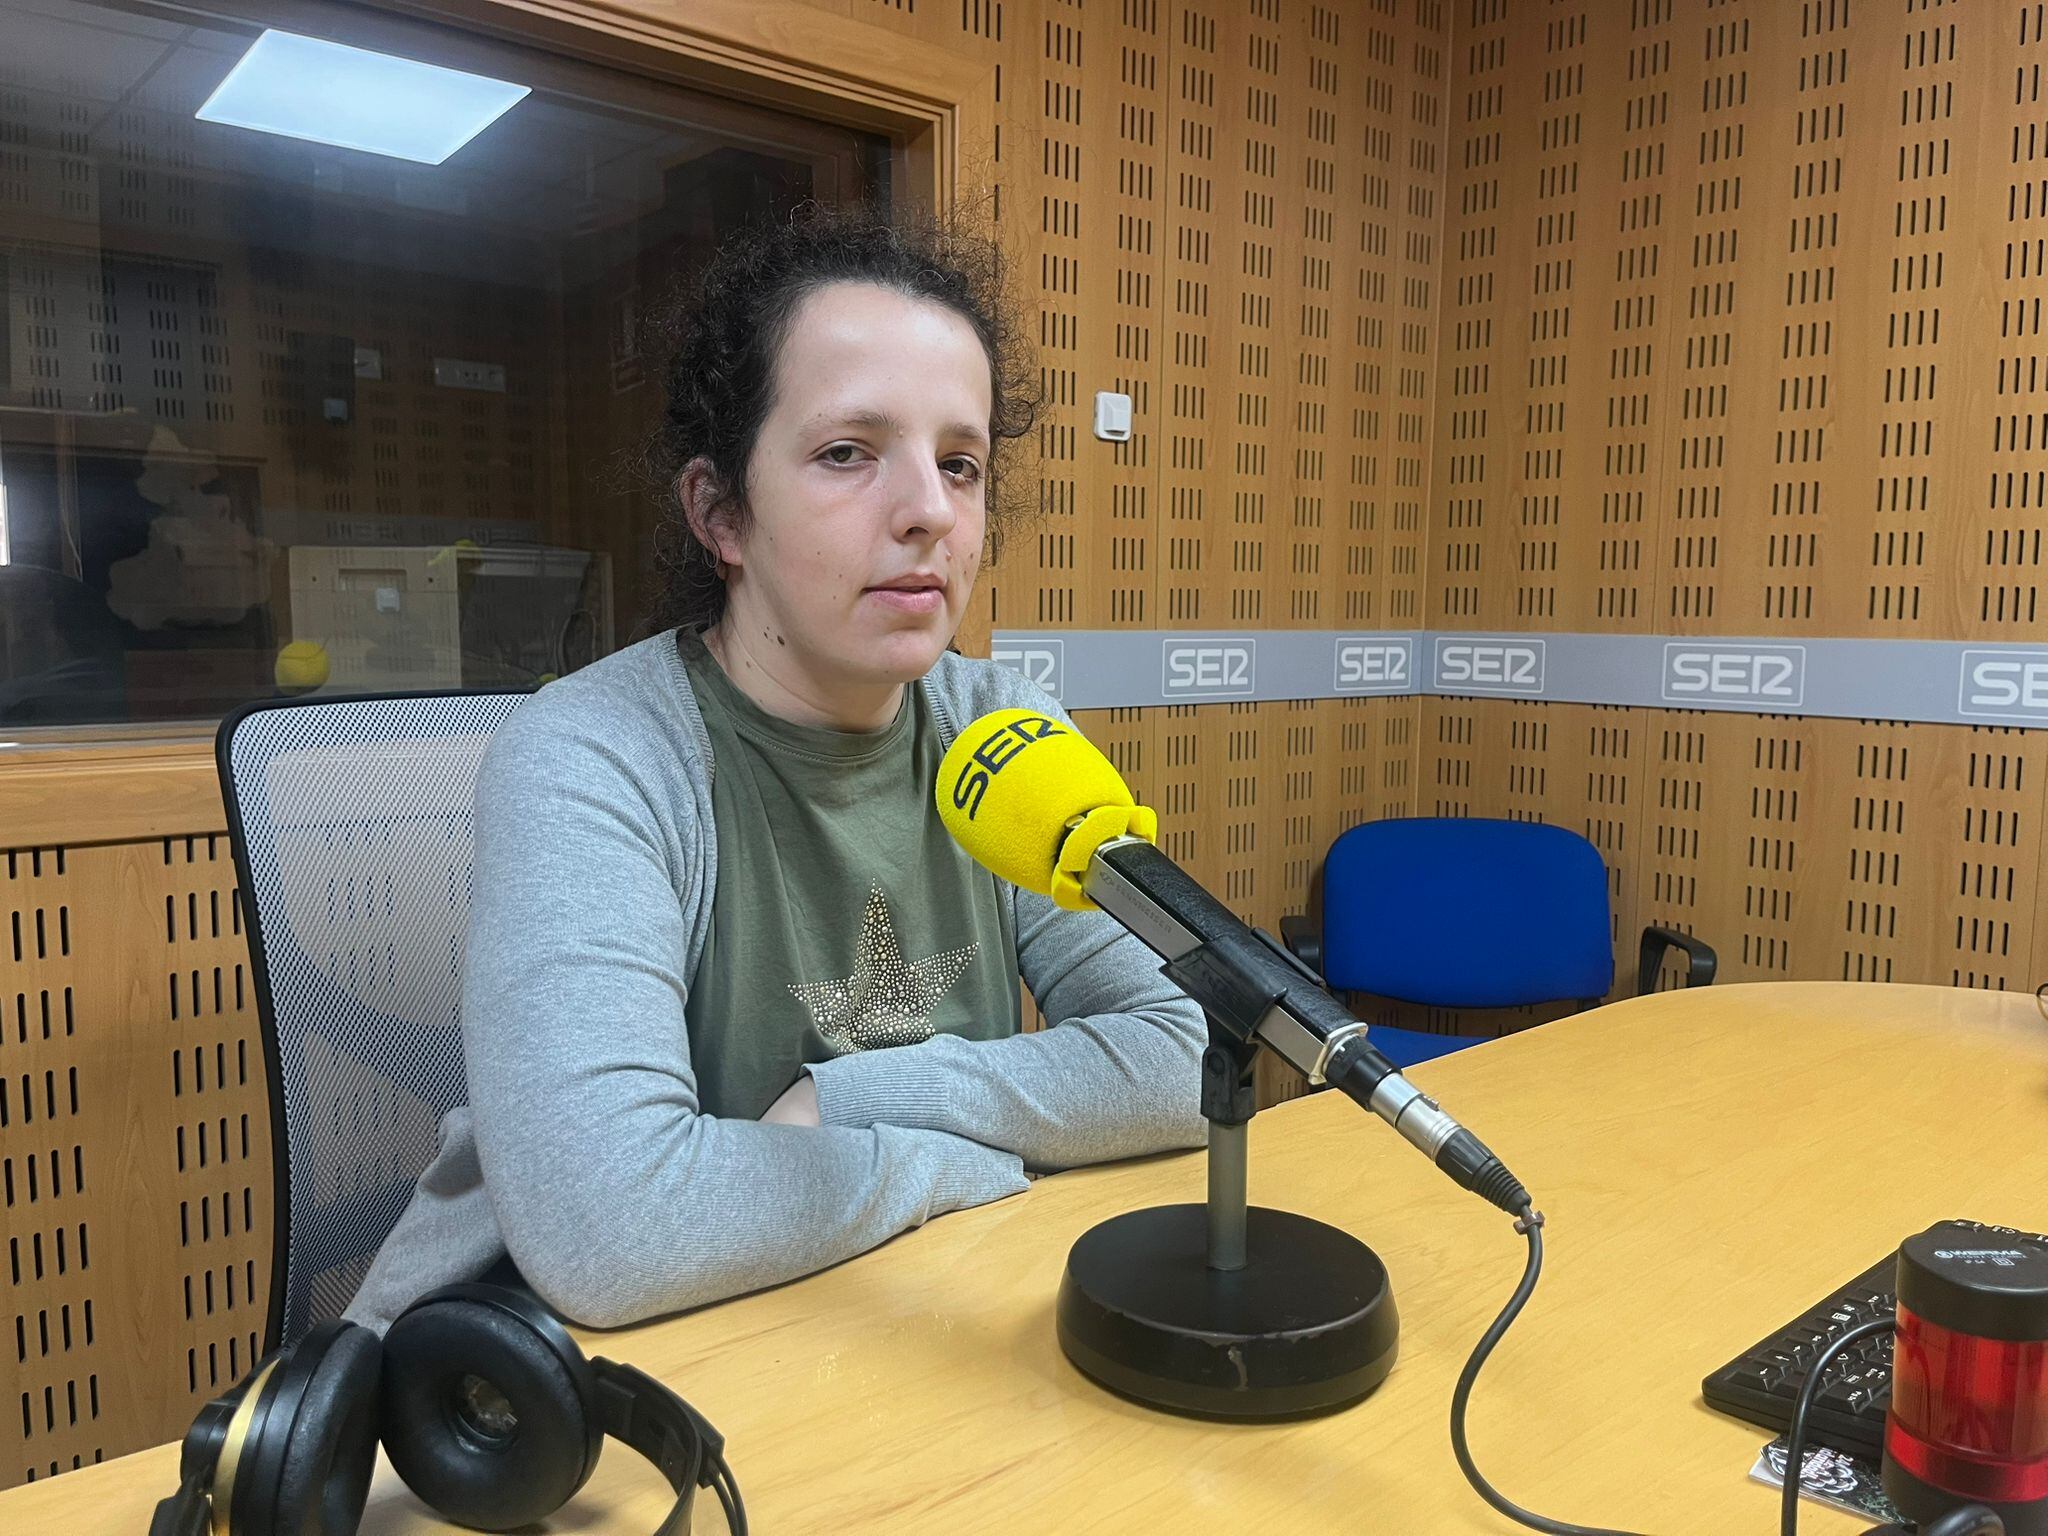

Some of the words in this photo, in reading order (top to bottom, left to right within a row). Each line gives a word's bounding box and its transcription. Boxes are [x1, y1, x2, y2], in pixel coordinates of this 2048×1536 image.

[1169, 648, 1248, 687] SER
[1340, 647, 1406, 681] SER
[1441, 647, 1537, 683] SER
[1671, 653, 1793, 695] SER
[1971, 662, 2048, 707] SE
[953, 717, 1068, 821] SER
